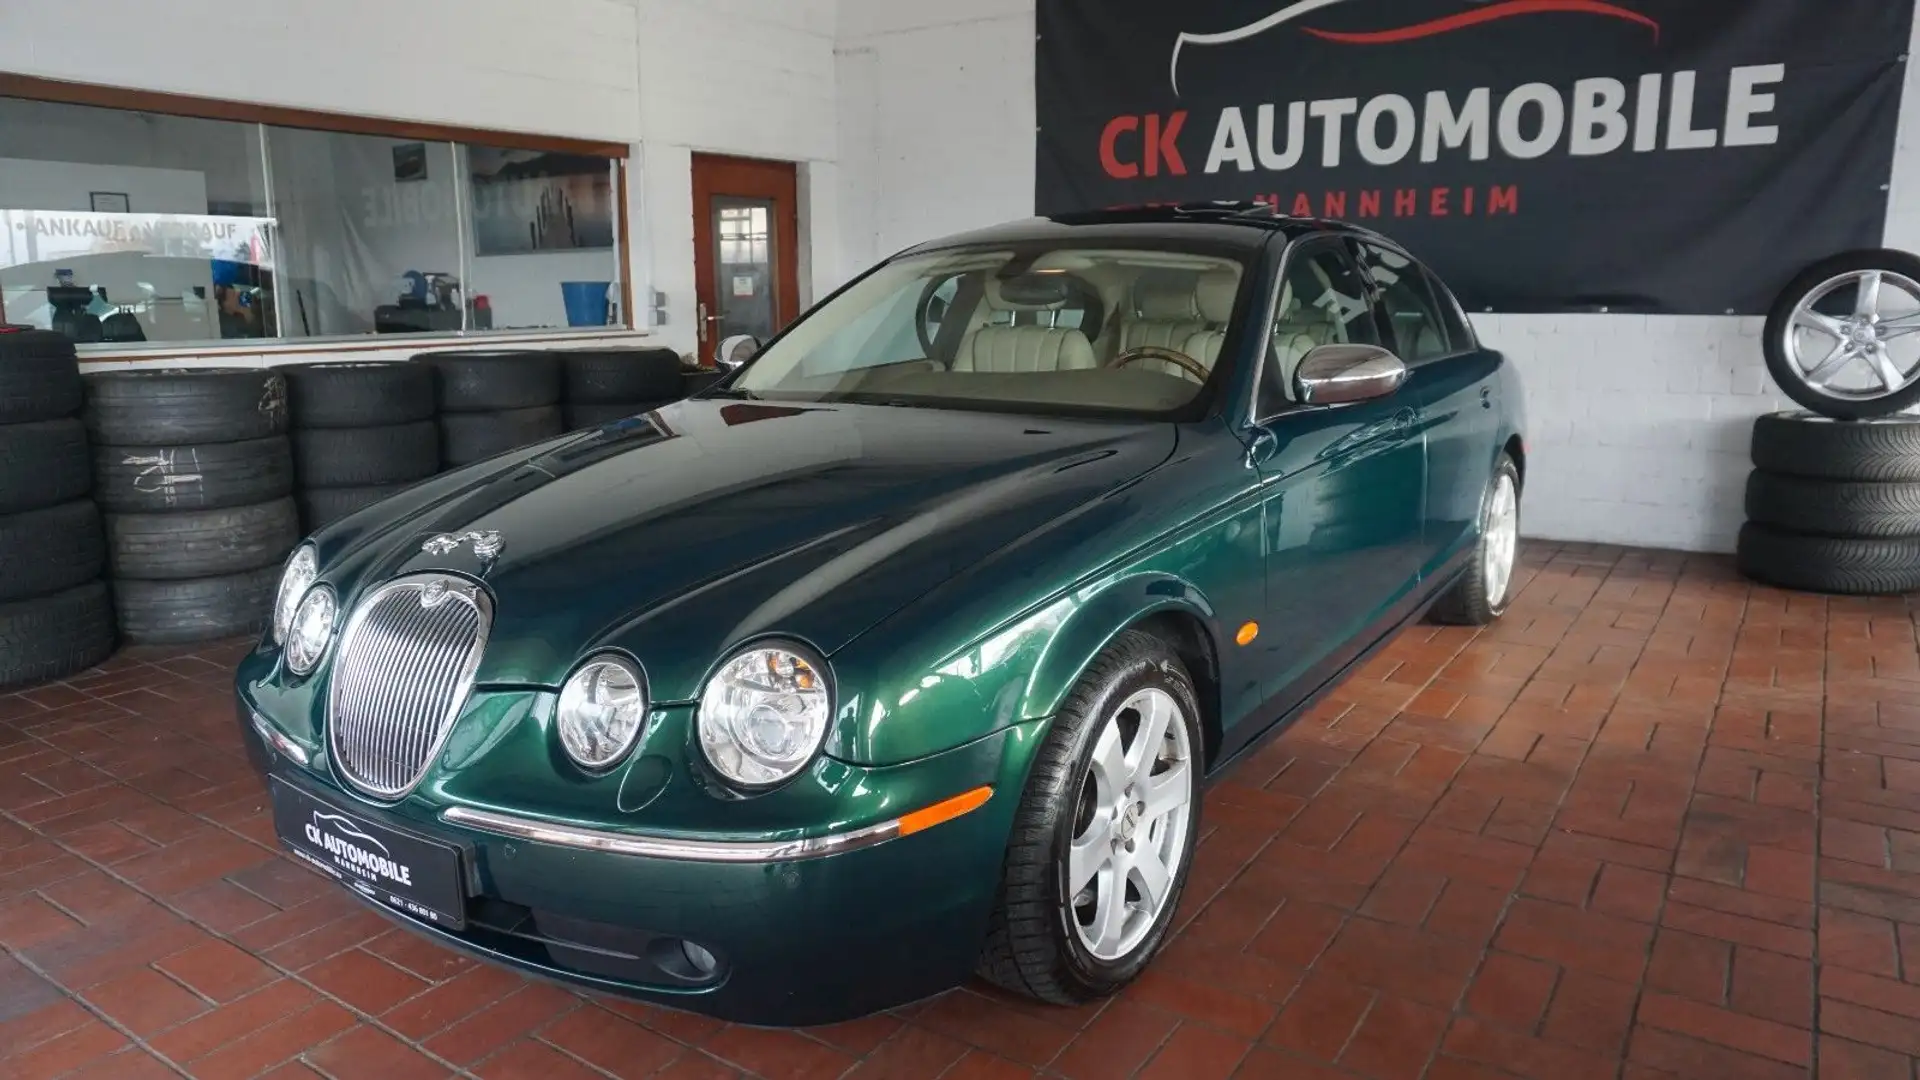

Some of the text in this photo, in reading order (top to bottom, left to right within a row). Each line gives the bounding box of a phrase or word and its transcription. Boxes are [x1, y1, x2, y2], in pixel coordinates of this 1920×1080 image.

[1099, 63, 1786, 179] CK AUTOMOBILE
[304, 823, 323, 847] CK
[324, 833, 412, 886] AUTOMOBILE
